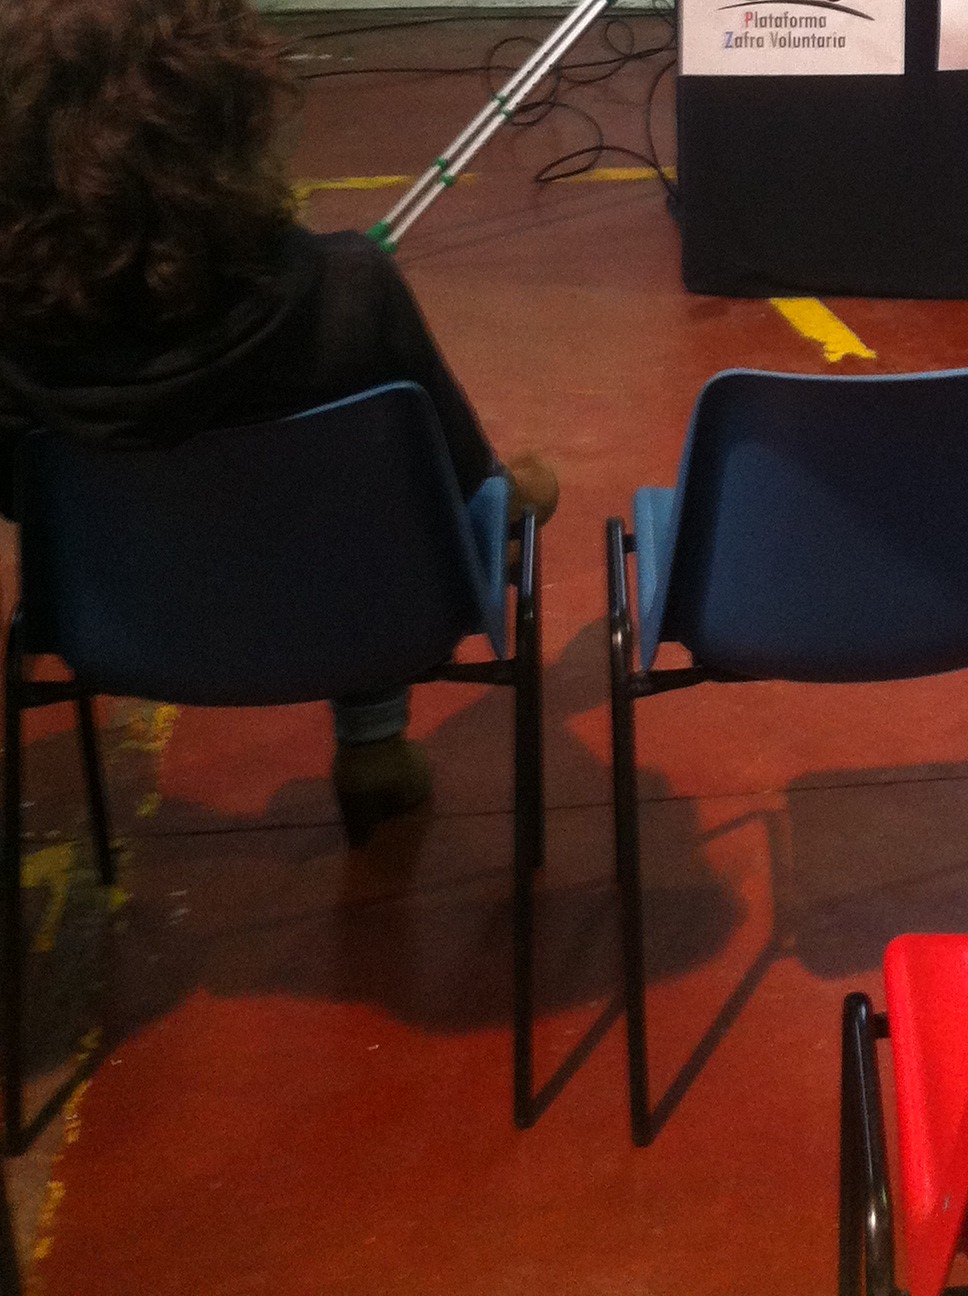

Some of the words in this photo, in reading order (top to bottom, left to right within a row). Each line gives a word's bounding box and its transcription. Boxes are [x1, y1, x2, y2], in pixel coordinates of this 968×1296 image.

[744, 11, 827, 30] Plataforma
[723, 30, 765, 49] Zafra
[770, 30, 846, 49] Voluntaria
